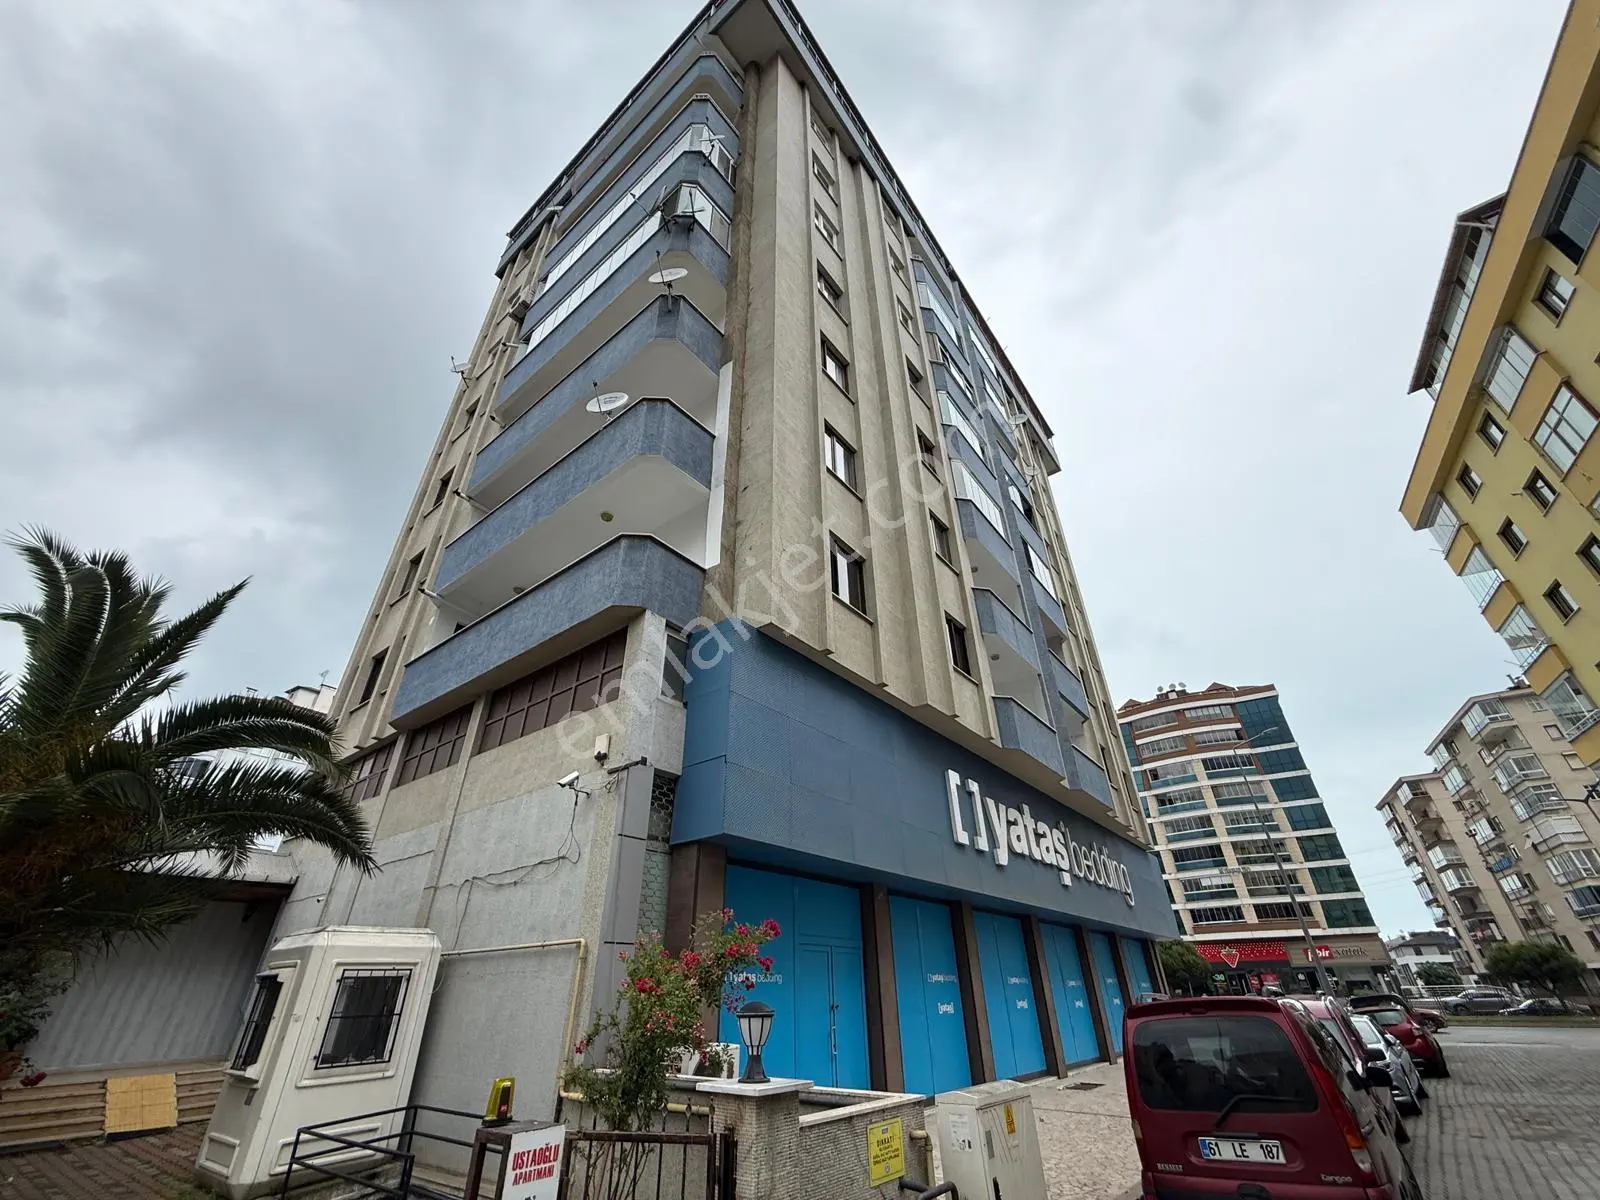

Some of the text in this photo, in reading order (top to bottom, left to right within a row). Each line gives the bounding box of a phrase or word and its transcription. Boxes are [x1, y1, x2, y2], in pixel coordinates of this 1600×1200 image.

[983, 797, 1135, 908] yataş bedding
[511, 1143, 560, 1171] USTAOĞLU
[1208, 1141, 1280, 1161] 61 LE 187
[512, 1165, 555, 1186] APARTMANI
